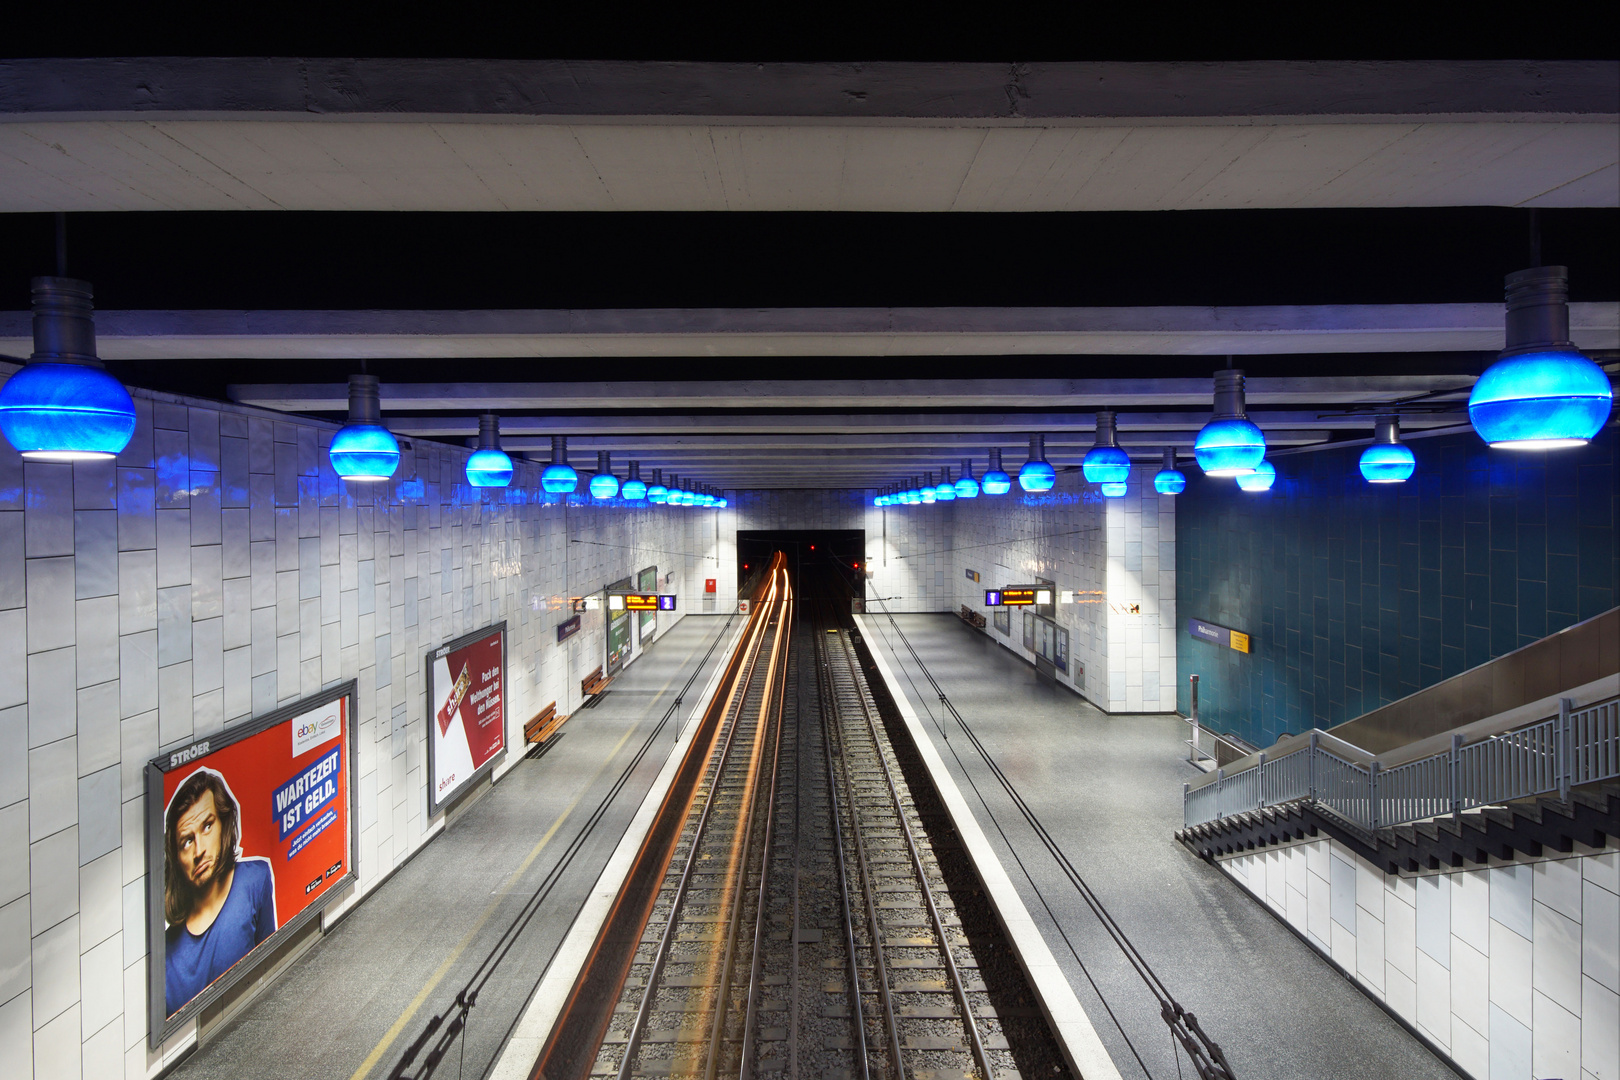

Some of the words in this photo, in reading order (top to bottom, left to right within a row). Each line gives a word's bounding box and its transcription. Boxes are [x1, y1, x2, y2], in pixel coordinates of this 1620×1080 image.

[1197, 625, 1219, 638] Philharmonie
[481, 669, 491, 683] Pack
[447, 680, 464, 716] share
[477, 703, 486, 716] den
[297, 721, 318, 738] ebay
[170, 741, 210, 767] STRÖER
[276, 751, 338, 813] WARTEZEIT
[439, 774, 456, 791] share
[283, 802, 302, 833] IST
[305, 779, 336, 815] GELD.
